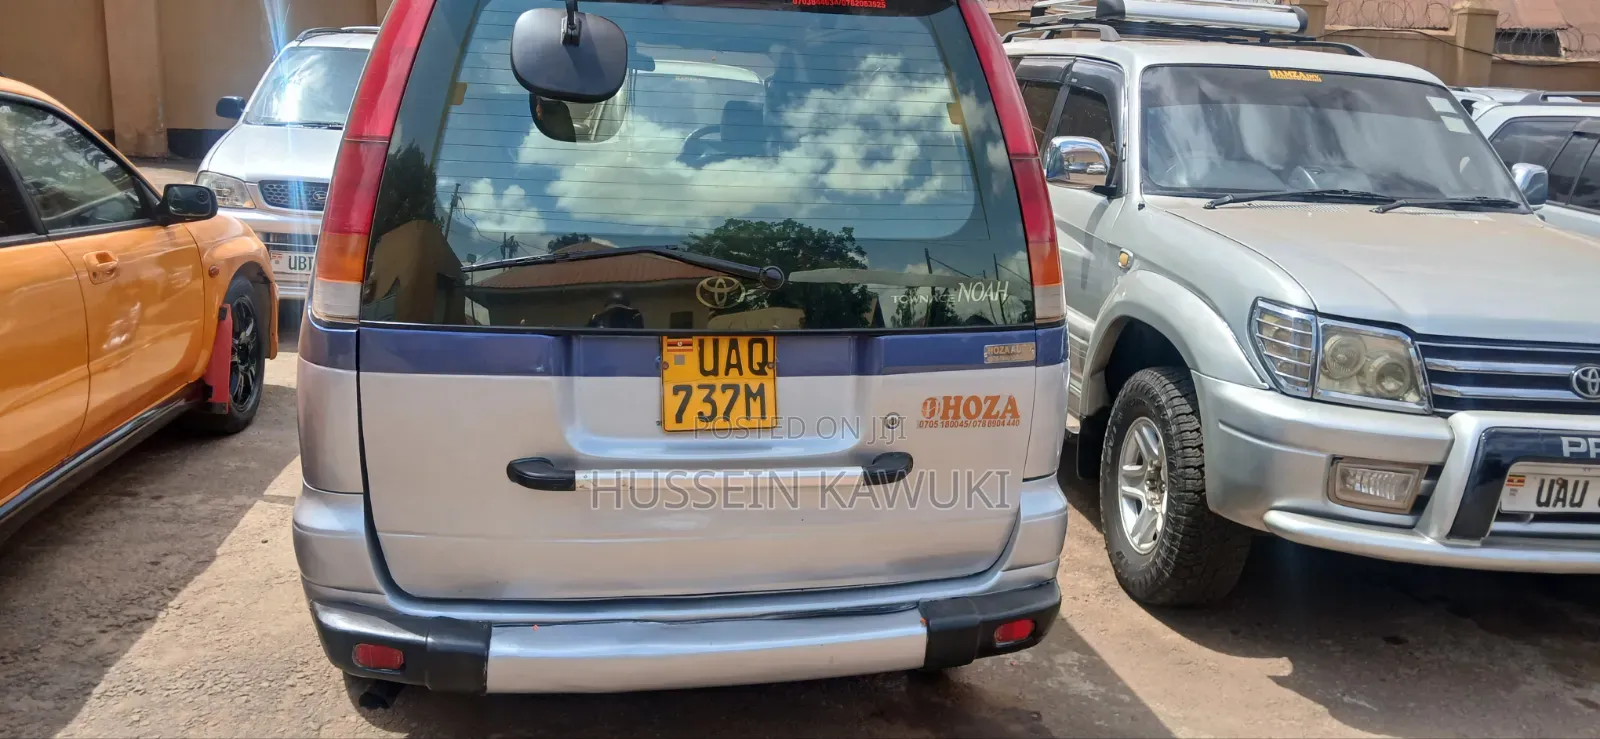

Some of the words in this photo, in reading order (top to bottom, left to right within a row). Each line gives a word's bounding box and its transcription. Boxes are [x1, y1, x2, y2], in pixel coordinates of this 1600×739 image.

[958, 281, 1009, 302] NOAH
[698, 337, 769, 376] UAQ
[672, 383, 766, 424] 737M
[940, 395, 1020, 420] HOZA
[919, 420, 938, 429] 0705
[1536, 477, 1590, 508] UAU
